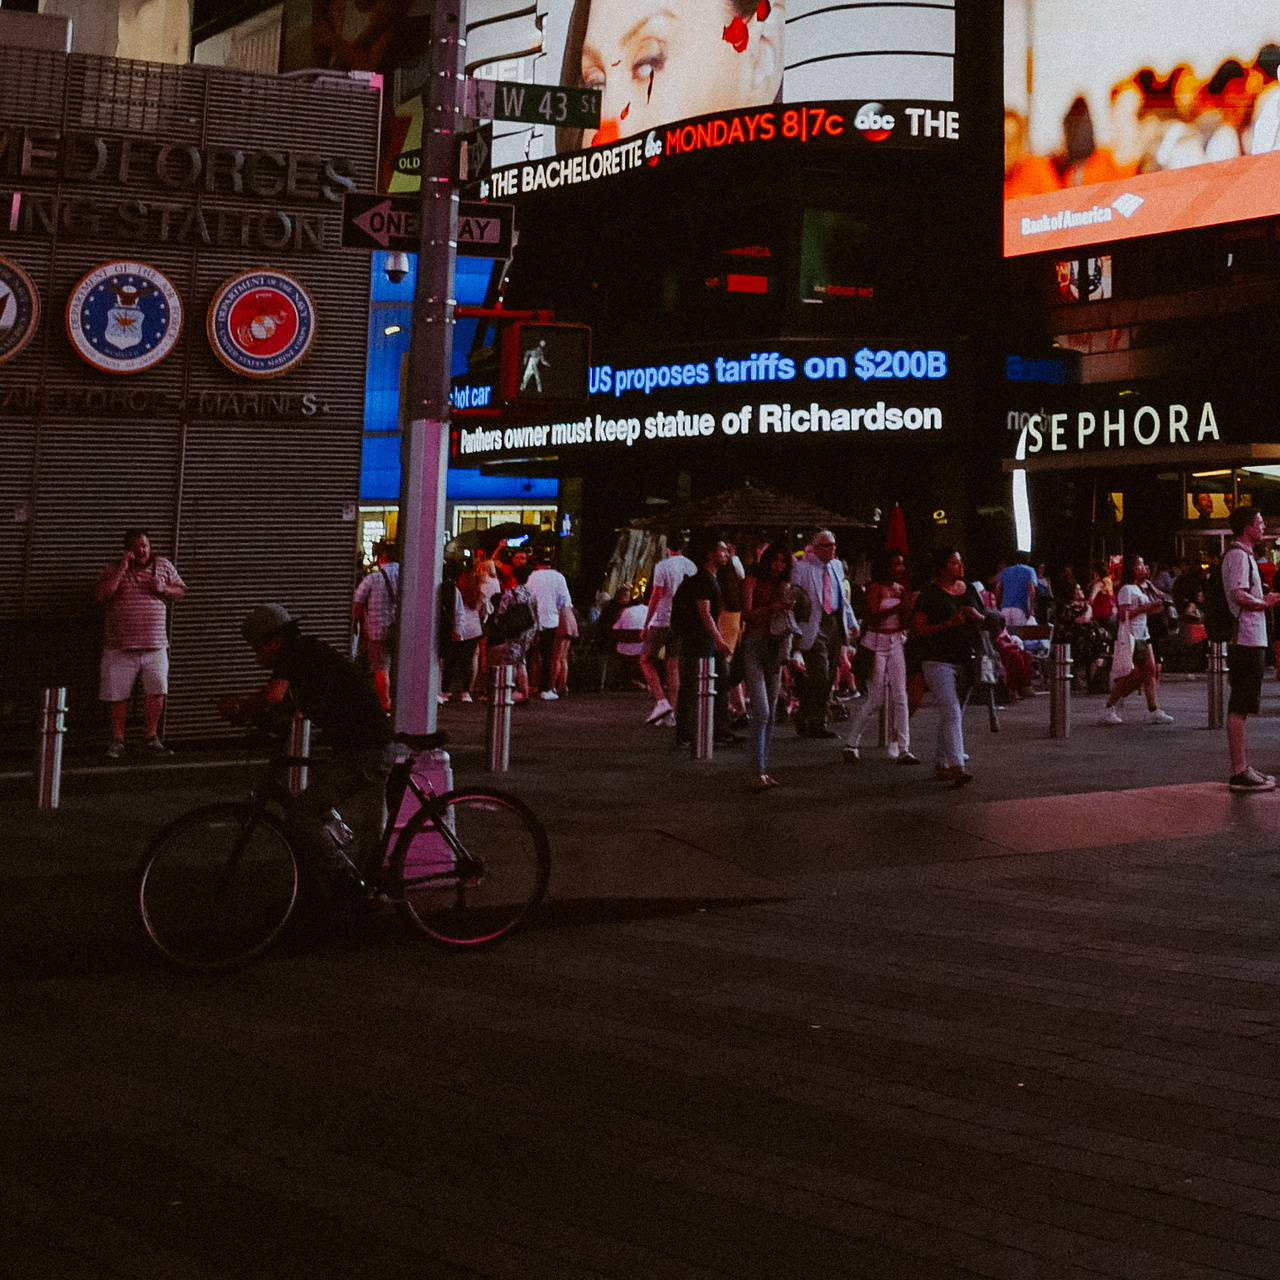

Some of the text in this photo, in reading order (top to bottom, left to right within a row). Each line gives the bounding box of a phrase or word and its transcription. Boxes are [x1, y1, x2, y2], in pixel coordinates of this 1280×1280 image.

[503, 87, 525, 117] W
[539, 91, 568, 122] 43
[854, 111, 895, 130] abc
[905, 108, 959, 140] THE
[666, 112, 776, 155] MONDAYS
[119, 138, 358, 204] FORCES
[491, 169, 518, 198] THE
[521, 140, 643, 193] BACHELORETTE
[118, 200, 326, 252] STATION
[370, 211, 491, 240] ONE AY
[471, 386, 491, 406] car
[589, 365, 611, 394] US
[615, 363, 710, 397] proposes
[715, 352, 796, 383] tariffs
[804, 356, 847, 379] on
[854, 347, 947, 381] $200B
[200, 391, 317, 415] MARINES
[461, 401, 942, 454] Panthers owner must keep statue of Richardson
[1028, 402, 1220, 452] SEPHORA
